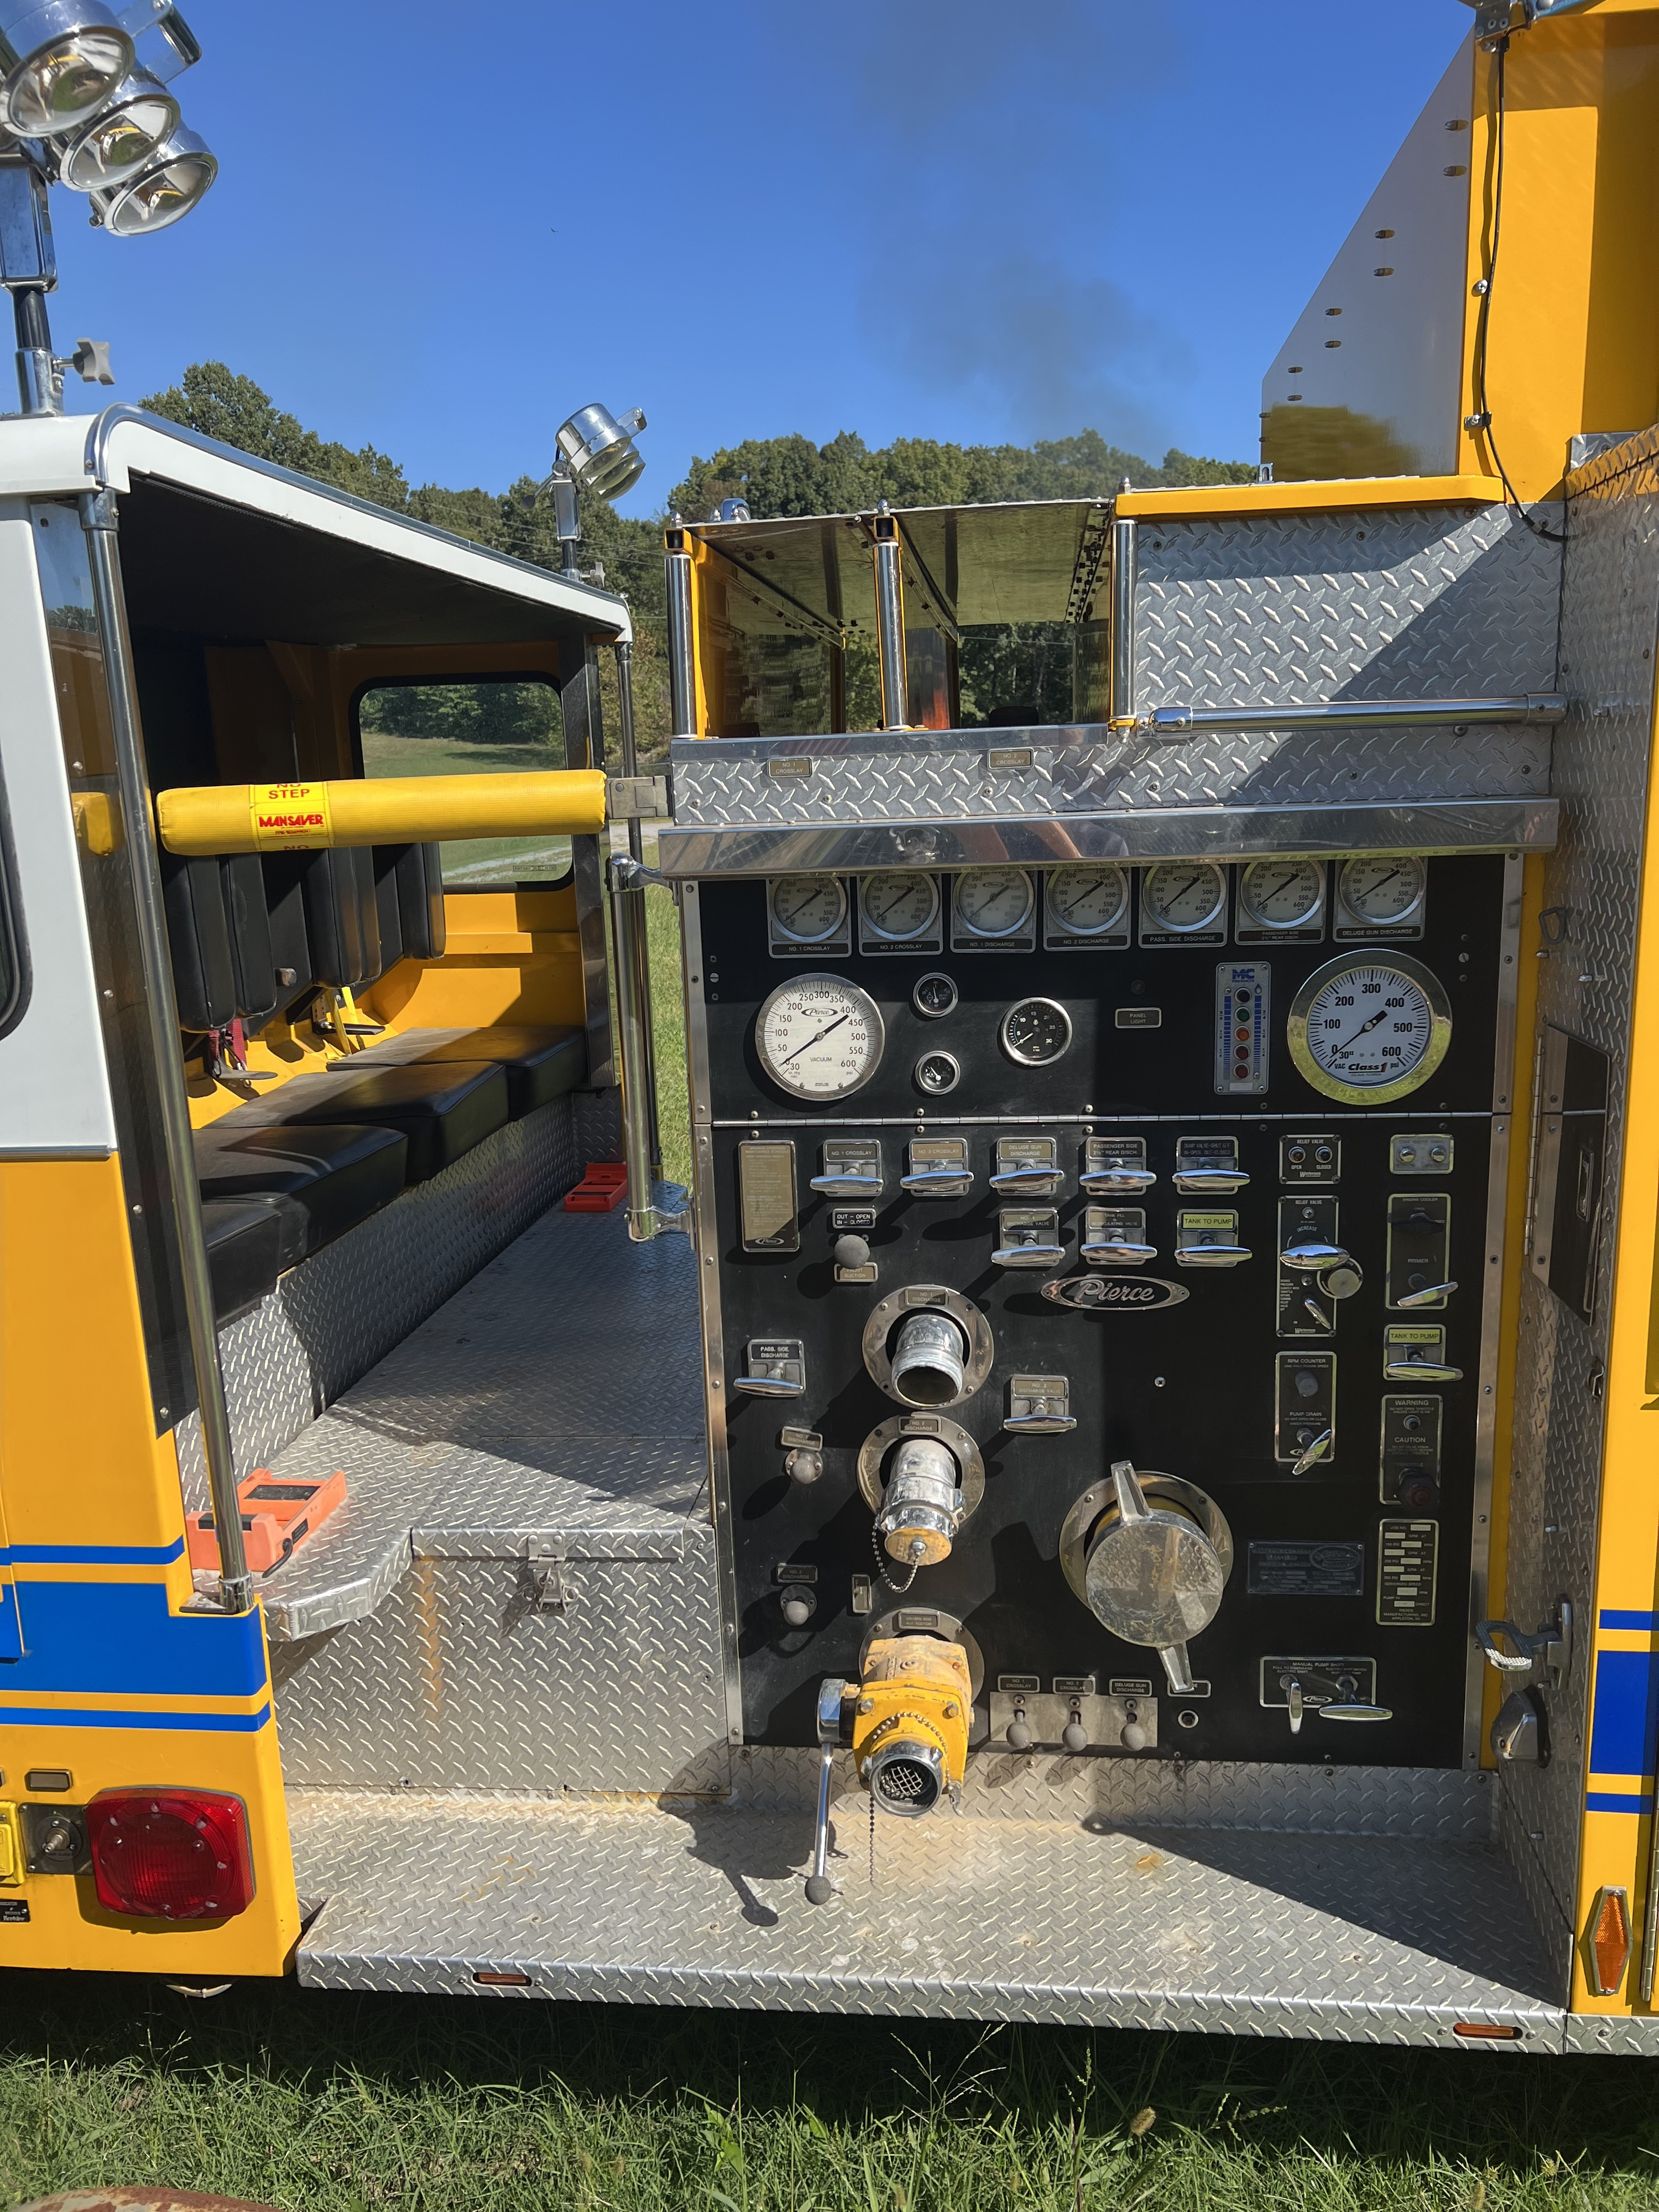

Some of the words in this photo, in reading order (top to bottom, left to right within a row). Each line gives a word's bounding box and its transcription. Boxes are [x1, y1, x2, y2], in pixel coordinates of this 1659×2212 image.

[269, 789, 310, 799] STEP
[259, 815, 324, 827] MANSAVER
[1233, 969, 1255, 979] MC
[1362, 983, 1381, 993] 300
[1335, 997, 1354, 1006] 200
[1385, 998, 1404, 1008] 400
[1324, 1019, 1340, 1029] 100
[1394, 1023, 1412, 1032] 500
[1332, 1045, 1338, 1054] 0
[1383, 1047, 1401, 1056] 600
[1074, 1279, 1155, 1303] Pierce
[788, 1437, 815, 1445] DISCHARGE
